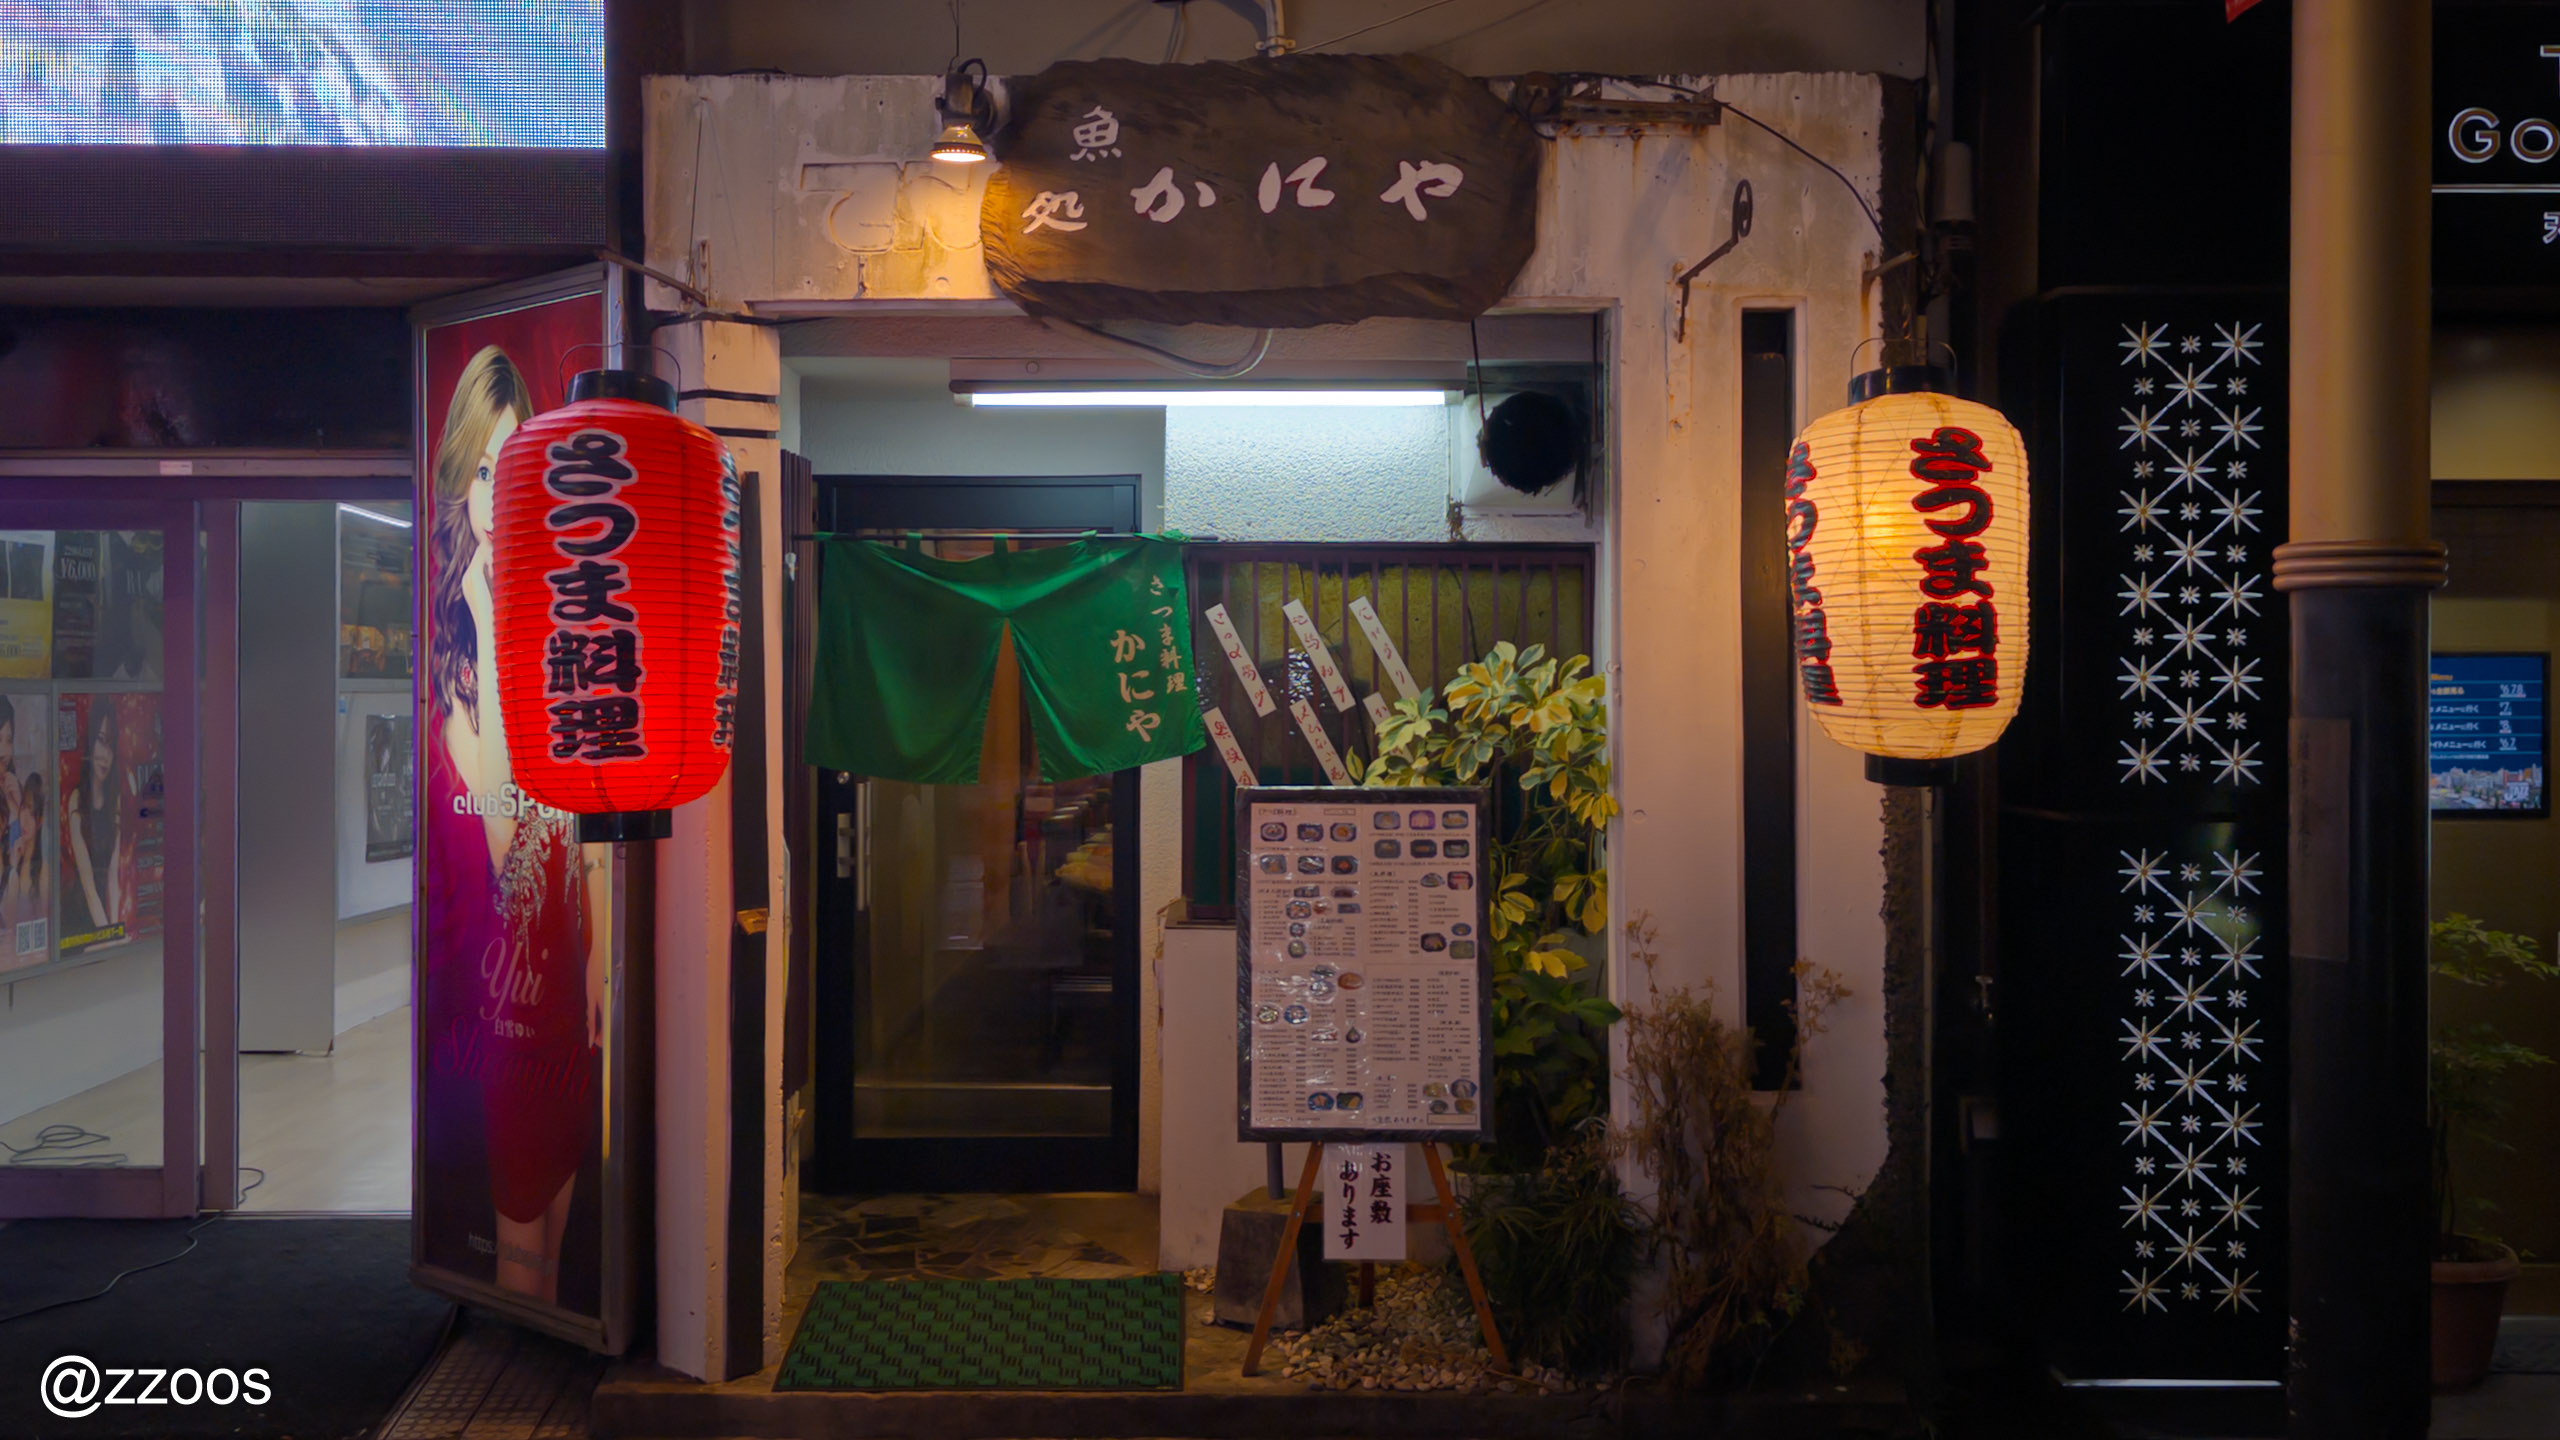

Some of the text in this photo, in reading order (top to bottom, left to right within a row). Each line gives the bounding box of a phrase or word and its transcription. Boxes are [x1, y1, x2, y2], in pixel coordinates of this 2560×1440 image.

[1130, 155, 1463, 224] かにや
[543, 428, 649, 763] さつま料理
[1909, 426, 2000, 710] さつま料理
[1110, 629, 1161, 742] かにや
[1150, 575, 1188, 694] さつま料理
[1339, 1159, 1360, 1250] あります
[1370, 1151, 1393, 1225] お座敷
